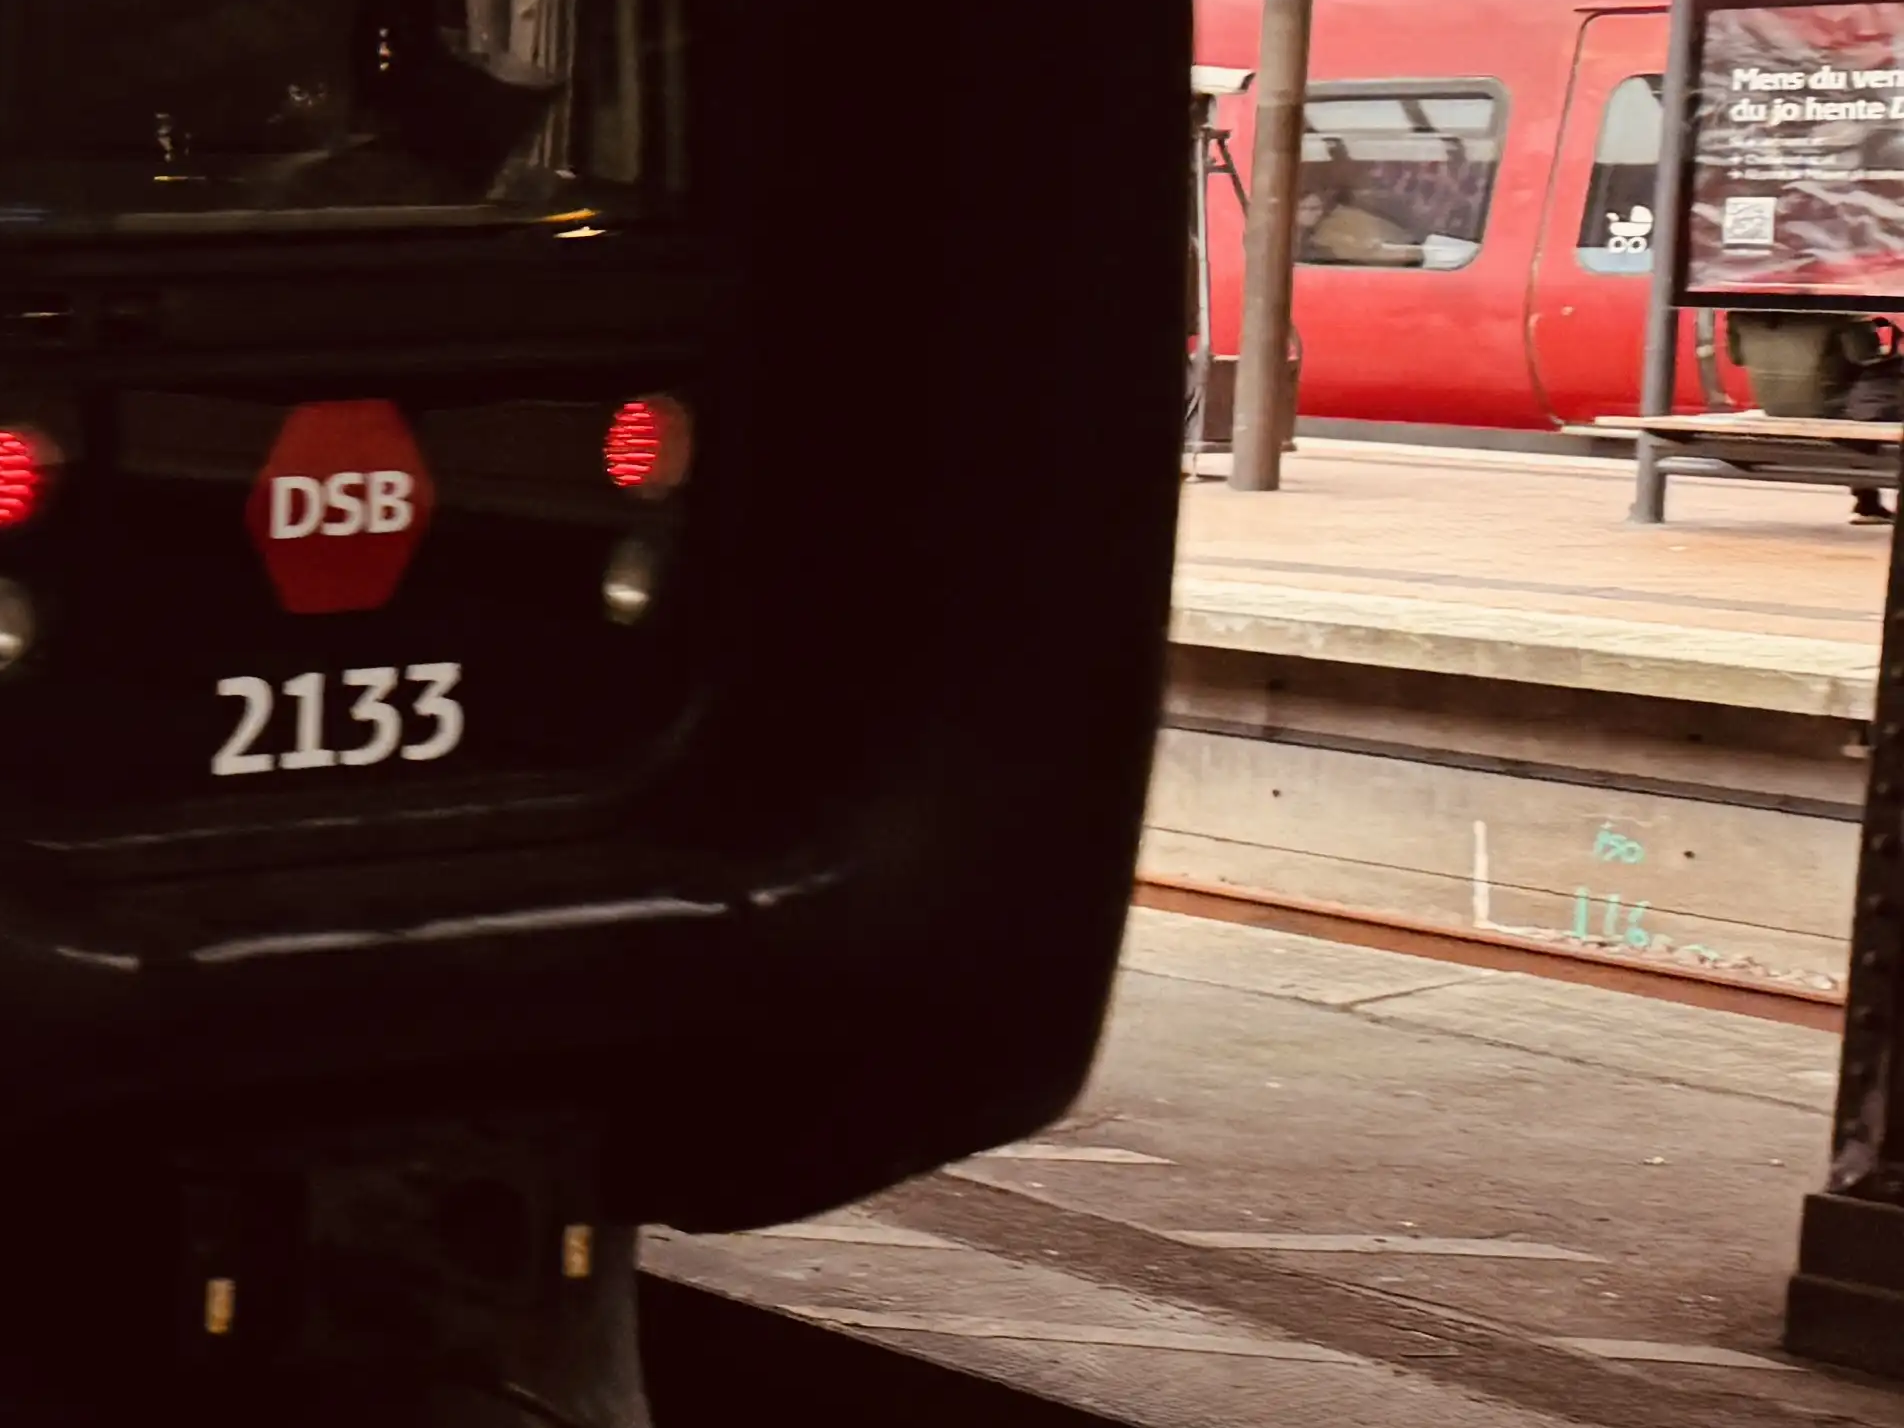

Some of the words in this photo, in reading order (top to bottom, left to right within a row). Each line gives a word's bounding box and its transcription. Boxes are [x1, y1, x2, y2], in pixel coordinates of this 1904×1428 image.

[1732, 68, 1805, 91] Mens
[1808, 65, 1847, 90] du
[1729, 98, 1767, 121] du
[1769, 98, 1800, 126] jo
[1805, 96, 1885, 121] hente
[269, 470, 413, 540] DSB
[211, 662, 465, 775] 2133
